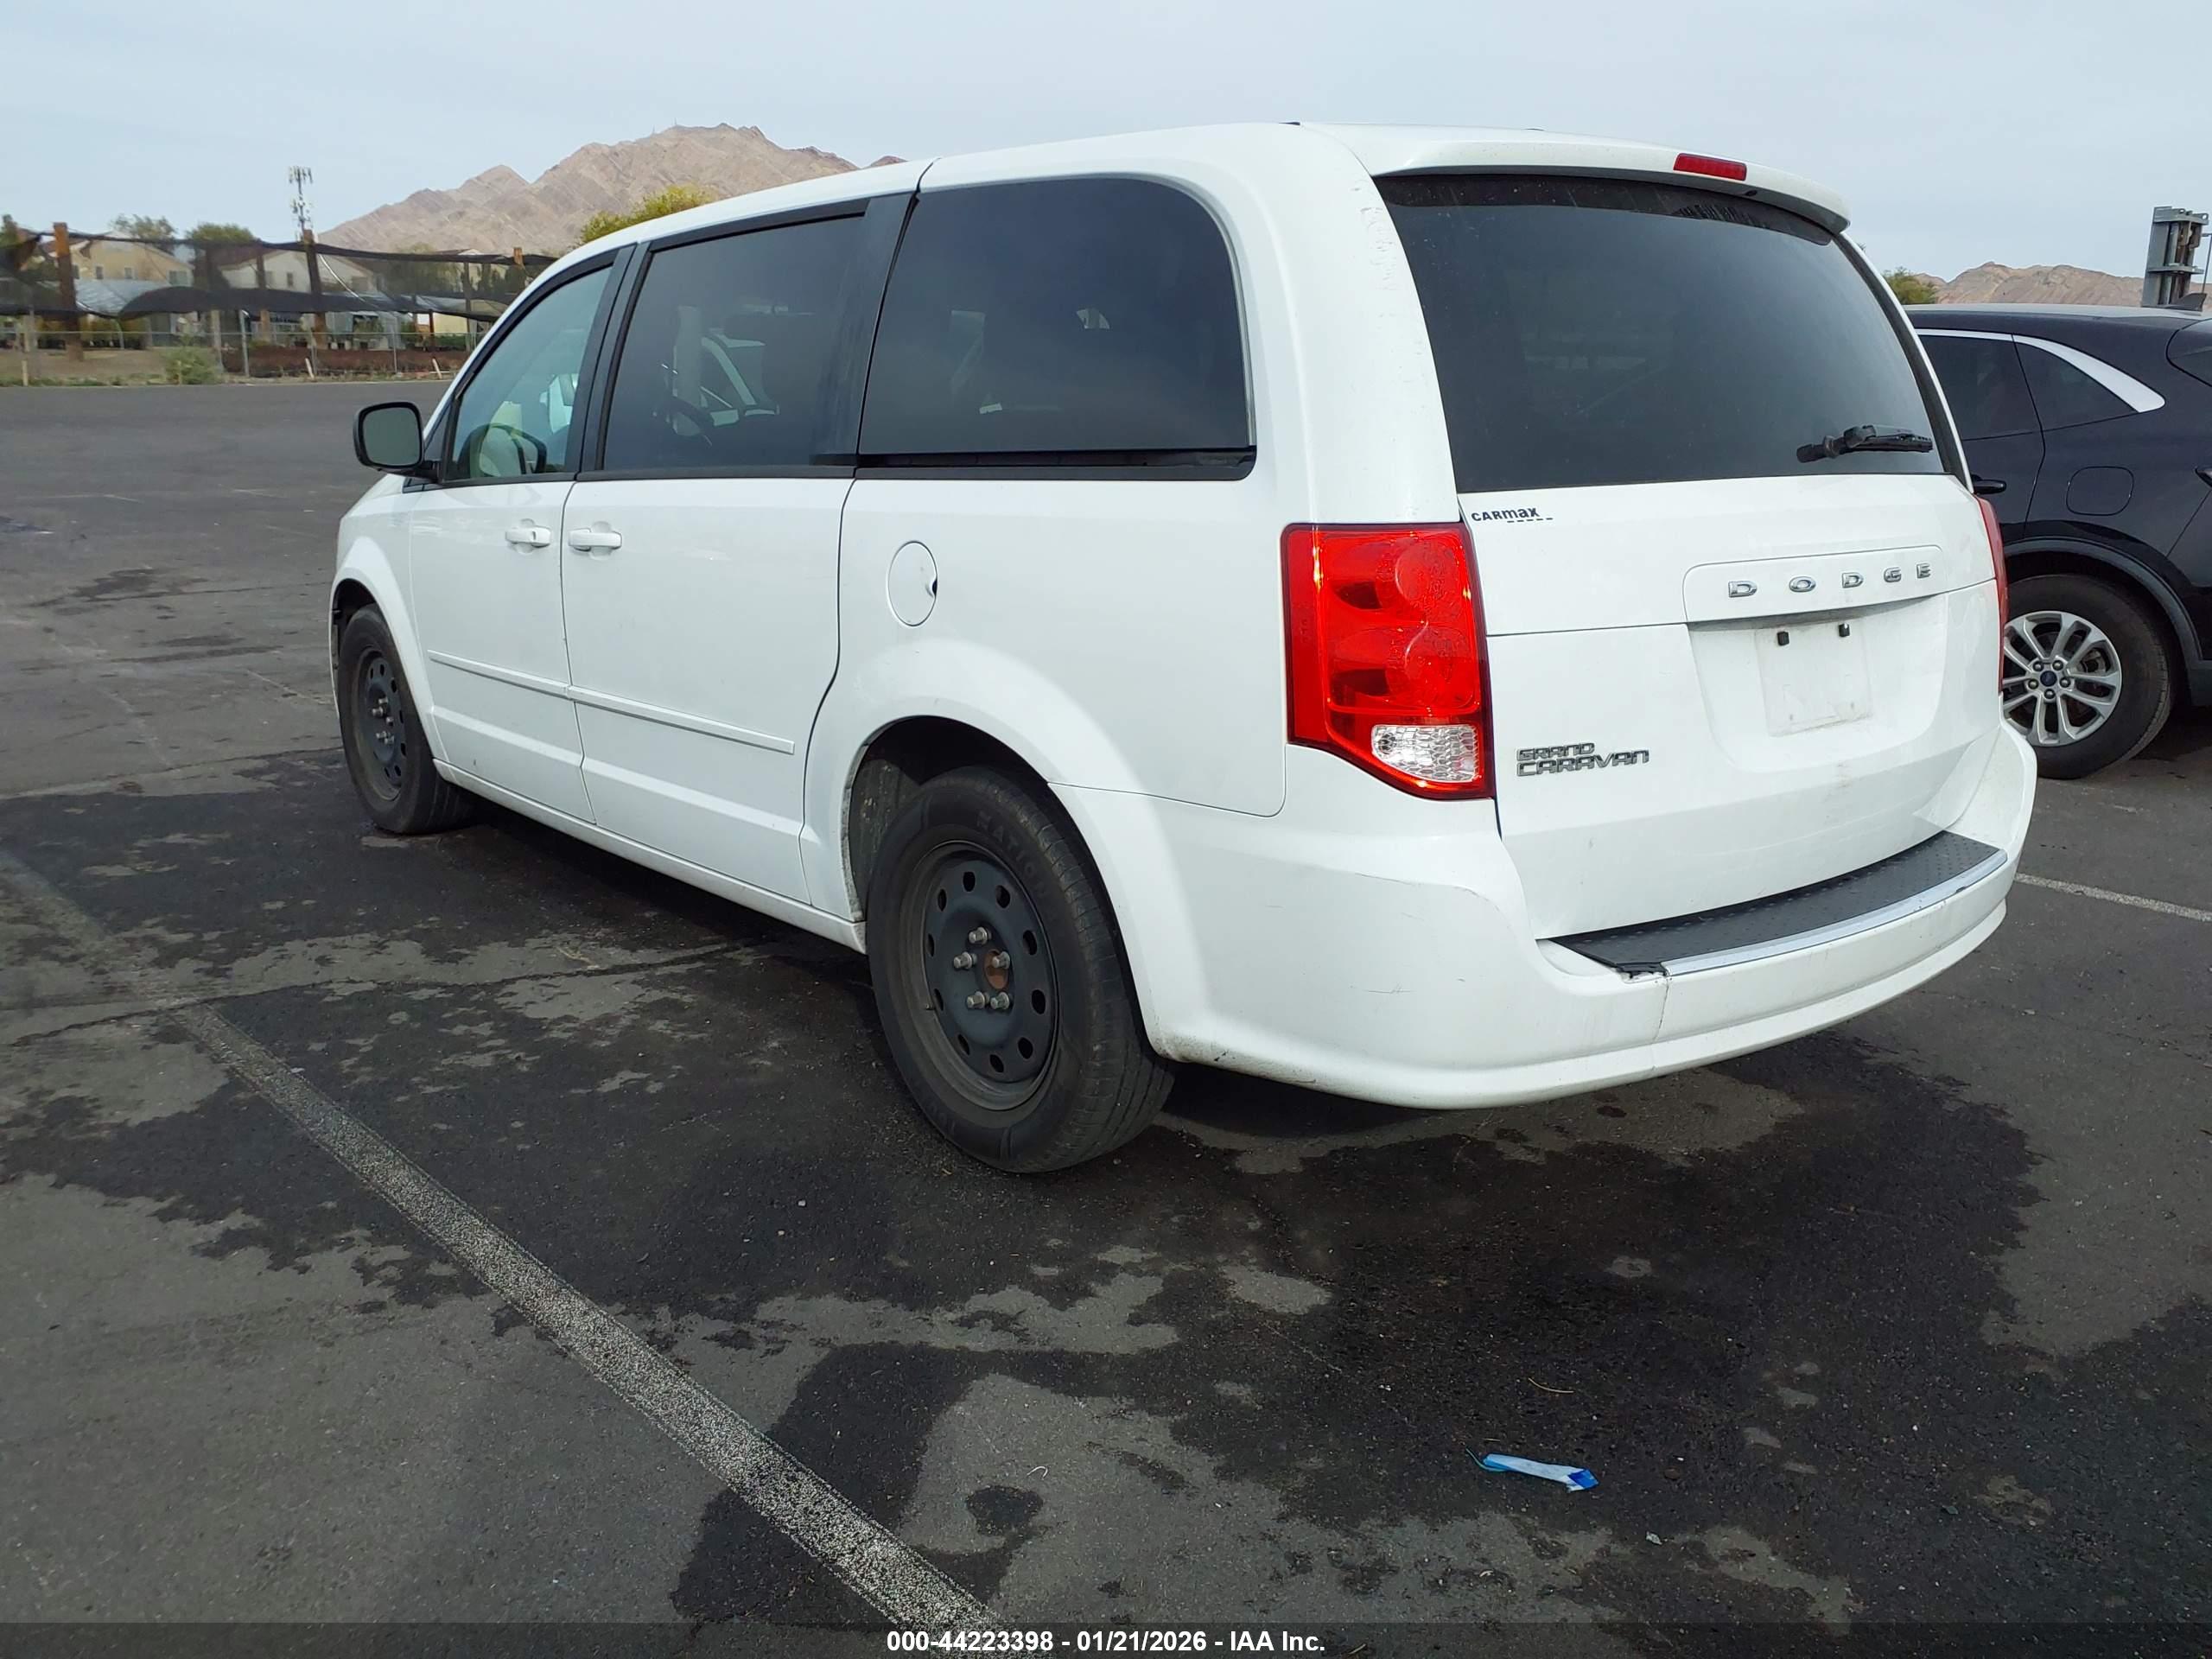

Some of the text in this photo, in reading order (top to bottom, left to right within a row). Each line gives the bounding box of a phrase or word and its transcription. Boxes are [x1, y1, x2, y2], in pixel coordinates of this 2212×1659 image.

[1727, 563, 1932, 599] DODGE
[1516, 742, 1595, 761] GRAND
[1516, 749, 1649, 777] CARAVAN
